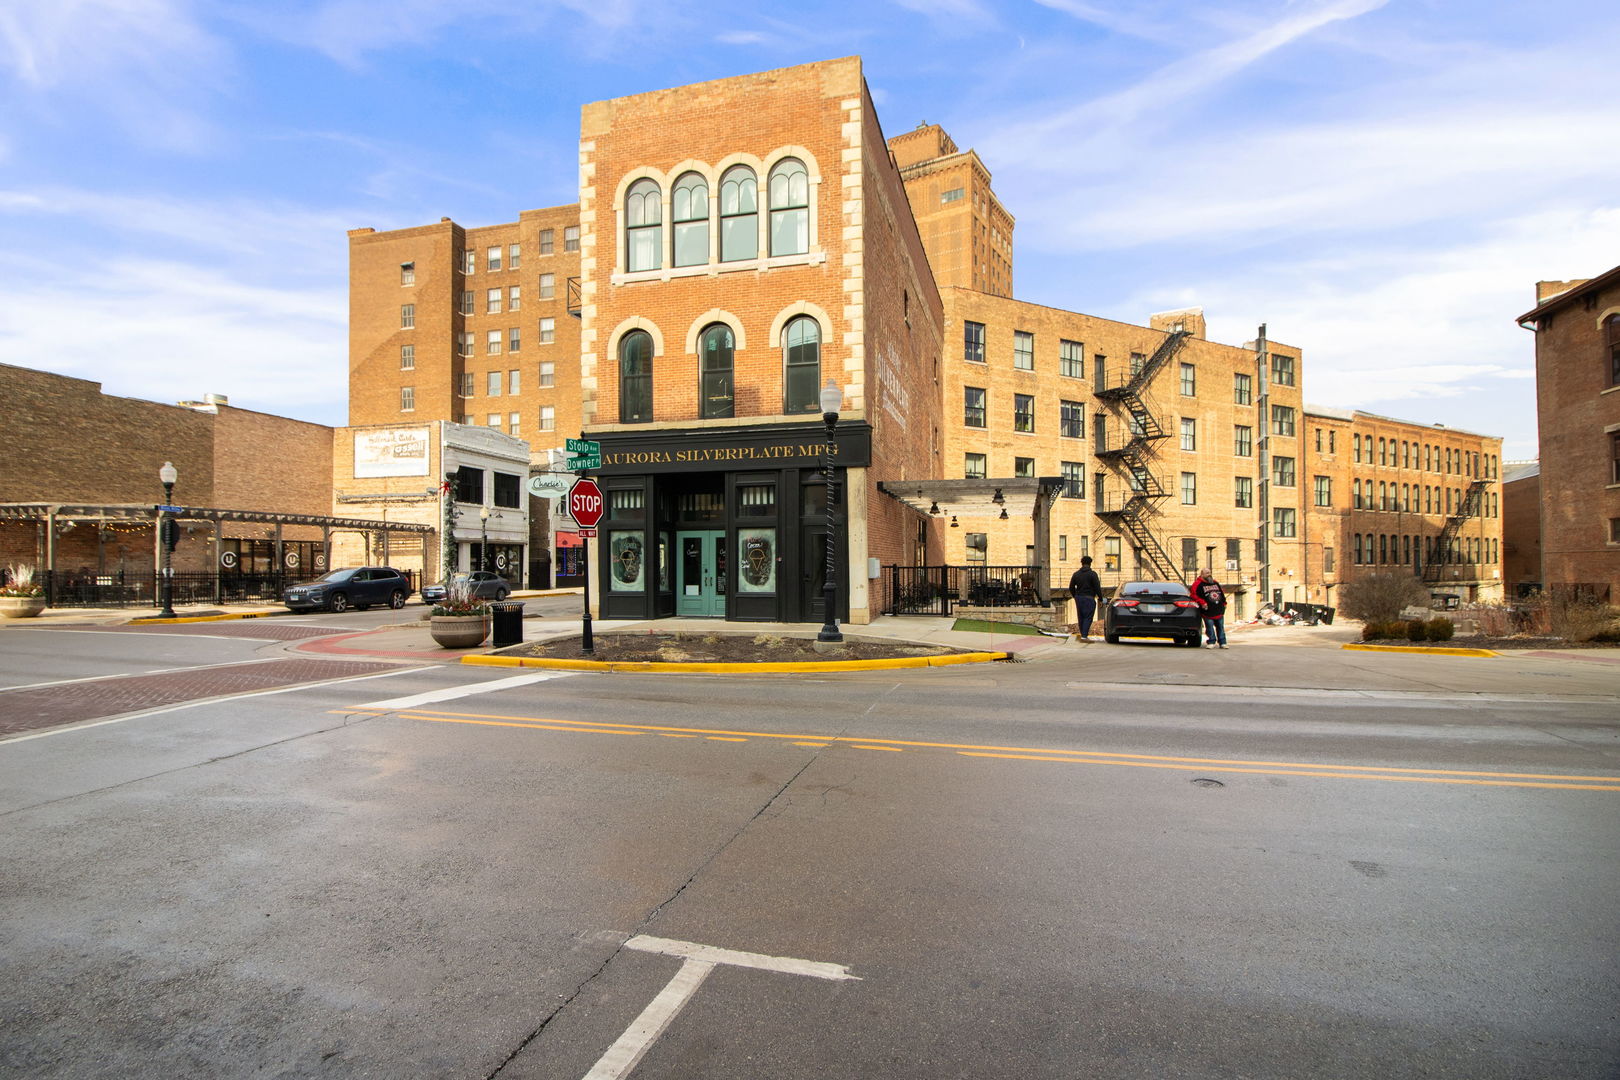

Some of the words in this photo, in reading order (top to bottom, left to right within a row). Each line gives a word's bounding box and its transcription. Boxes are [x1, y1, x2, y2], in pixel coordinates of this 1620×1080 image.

[568, 440, 589, 454] Stolp
[602, 451, 672, 465] AURORA
[676, 444, 795, 462] SILVERPLATE
[567, 458, 594, 470] Downer
[533, 477, 563, 489] Charlie's
[573, 494, 601, 512] STOP
